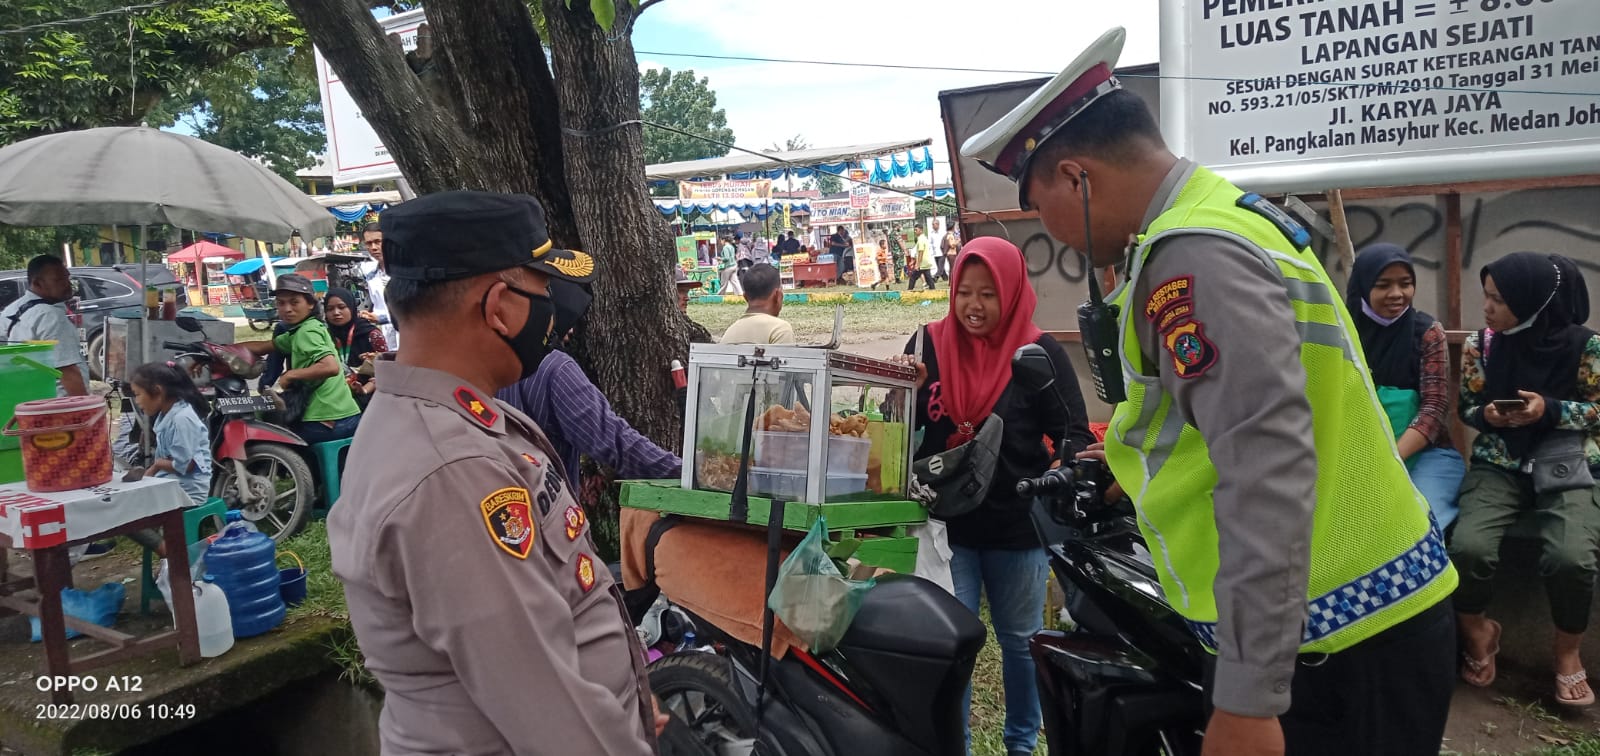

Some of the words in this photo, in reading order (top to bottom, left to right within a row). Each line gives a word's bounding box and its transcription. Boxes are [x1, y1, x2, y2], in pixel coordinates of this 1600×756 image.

[1220, 16, 1292, 49] LUAS
[1299, 0, 1404, 37] TANAH
[1301, 28, 1438, 65] LAPANGAN
[1446, 15, 1534, 47] SEJATI
[1208, 100, 1236, 115] NO.
[1240, 76, 1444, 112] 593.21/05/SKT/PM/2010
[1448, 65, 1525, 89] Tanggal
[1530, 63, 1553, 80] 31
[1561, 56, 1599, 76] Mei
[1226, 76, 1281, 96] SESUAI
[1285, 66, 1356, 89] DENGAN
[1361, 59, 1418, 79] SURAT
[1423, 42, 1554, 72] KETERANGAN
[1361, 97, 1438, 122] KARYA
[1444, 91, 1502, 115] JAYA
[1230, 136, 1260, 156] Kel.
[1265, 129, 1355, 155] Pangkalan
[1361, 121, 1440, 146] Masyhur
[1445, 117, 1484, 137] Kec.
[1490, 110, 1560, 133] Medan
